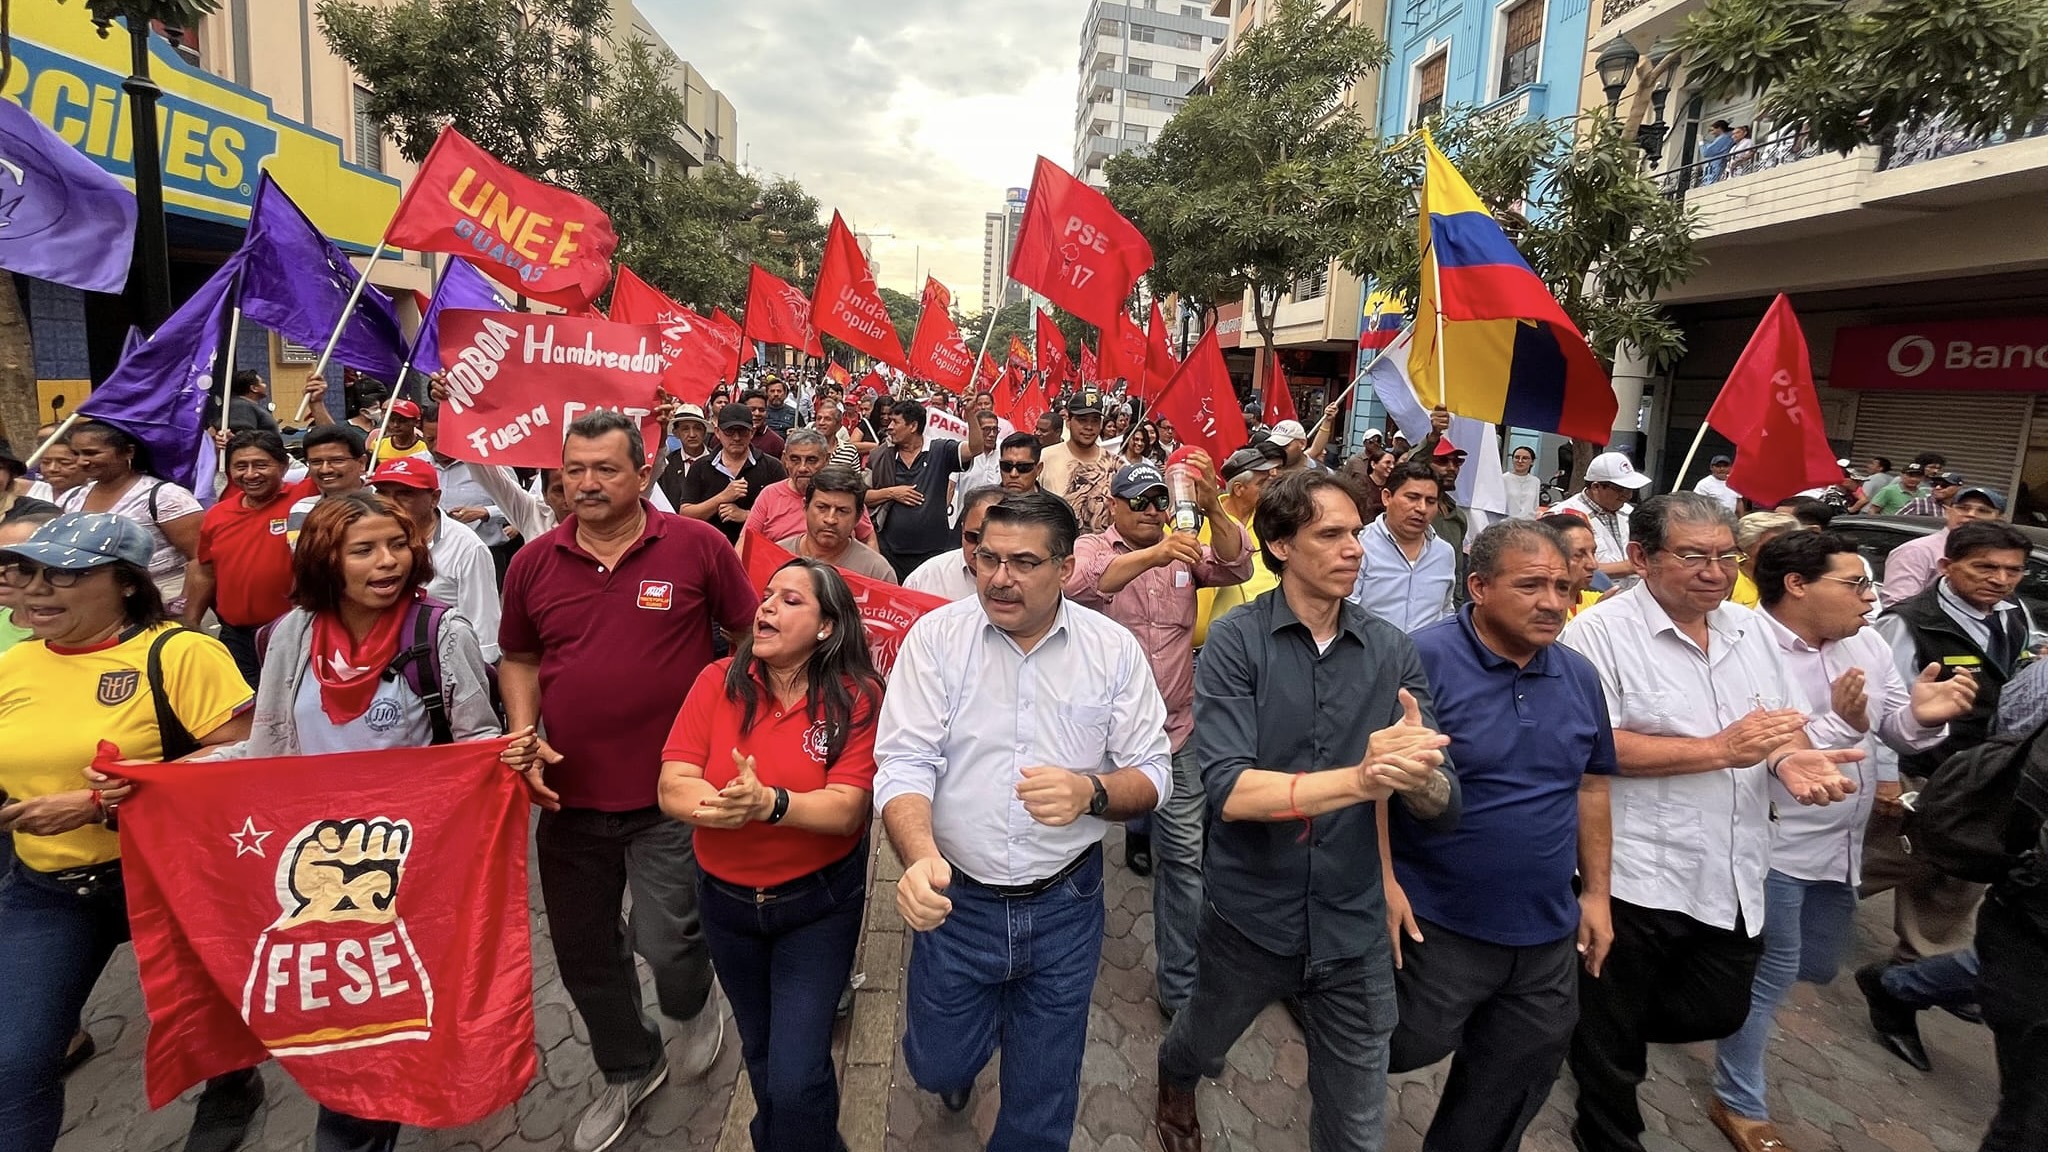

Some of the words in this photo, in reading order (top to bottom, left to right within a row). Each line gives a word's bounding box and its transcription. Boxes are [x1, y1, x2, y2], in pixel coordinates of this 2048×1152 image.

[1064, 215, 1110, 254] PSE
[1071, 264, 1095, 289] 17
[832, 301, 887, 340] Popular
[444, 317, 519, 415] NOBOA
[523, 324, 661, 374] Hambreador
[930, 352, 964, 377] Popular
[934, 341, 970, 368] Unidad
[466, 404, 551, 458] Fuera
[373, 708, 394, 722] JJO
[264, 931, 410, 1013] FESE
